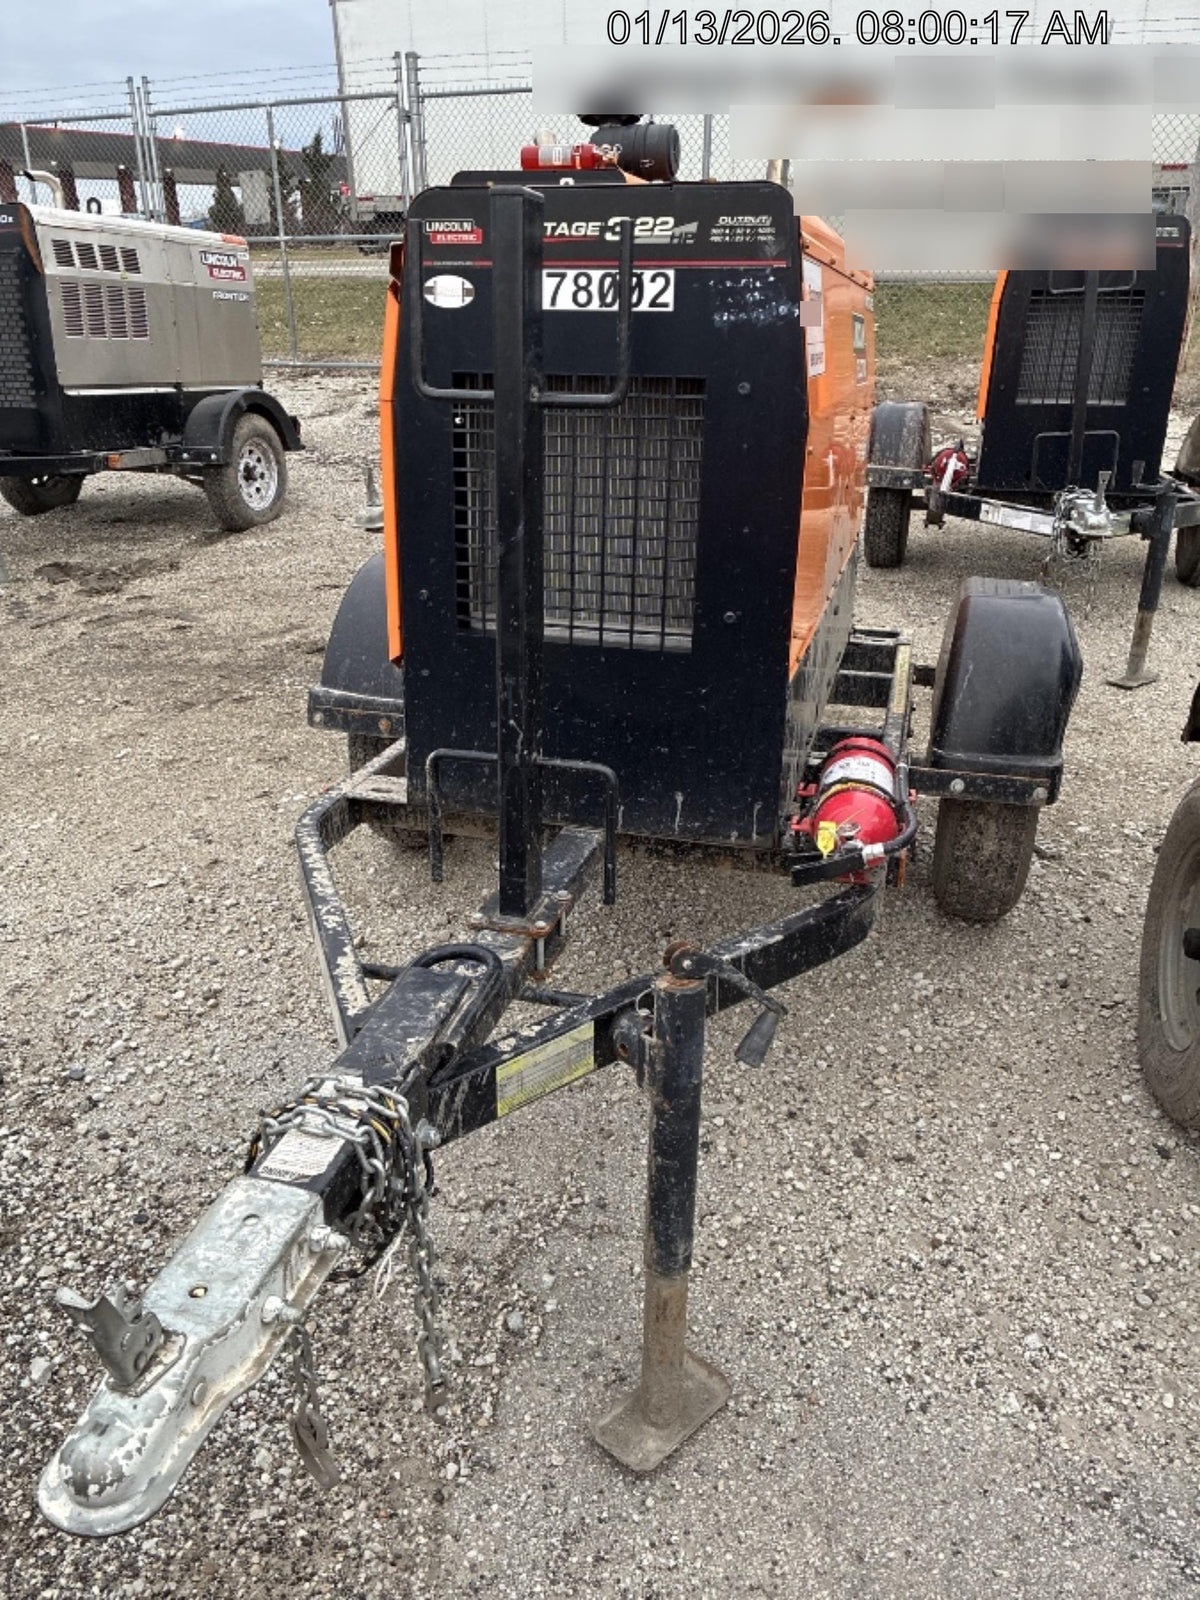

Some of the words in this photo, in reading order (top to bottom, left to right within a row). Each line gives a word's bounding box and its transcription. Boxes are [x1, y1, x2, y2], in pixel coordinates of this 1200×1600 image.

[425, 221, 472, 232] LINCOLN
[436, 234, 477, 242] ELECTRIC
[261, 1166, 304, 1180] ARNING
